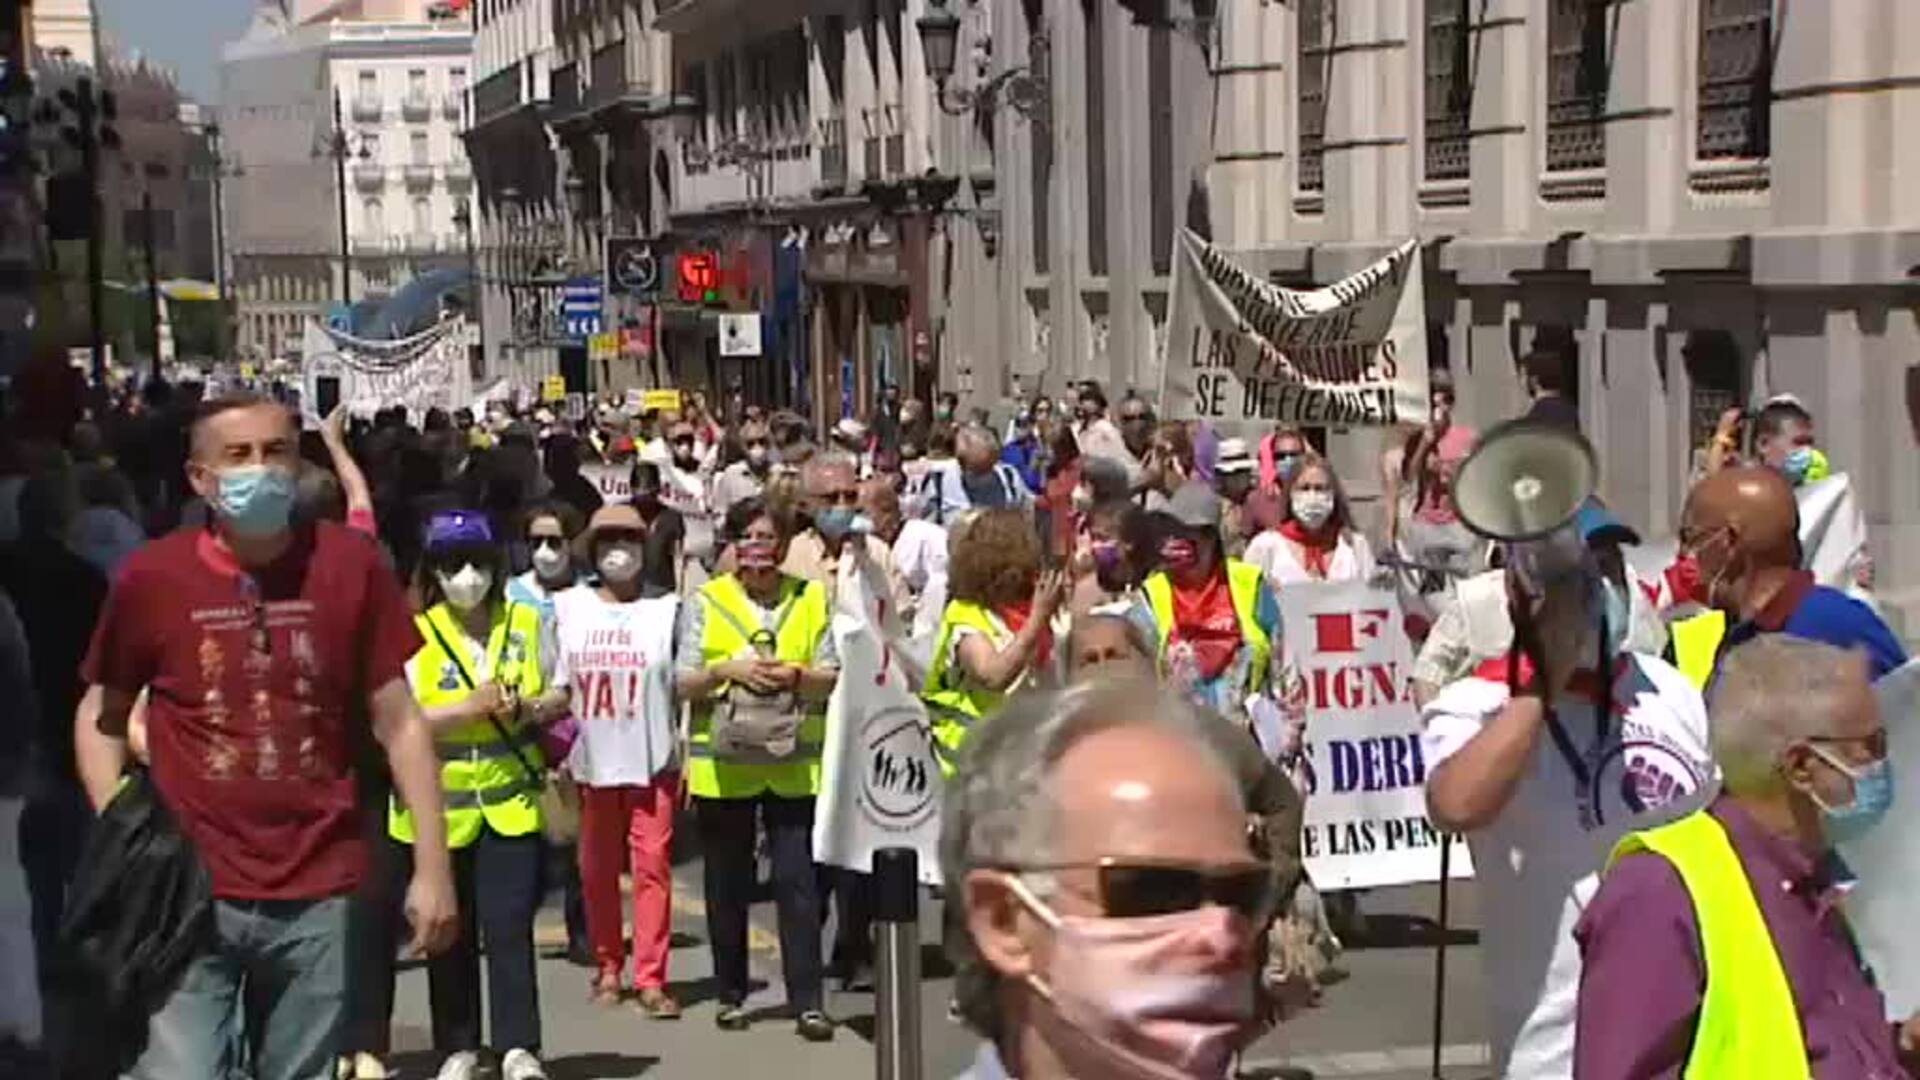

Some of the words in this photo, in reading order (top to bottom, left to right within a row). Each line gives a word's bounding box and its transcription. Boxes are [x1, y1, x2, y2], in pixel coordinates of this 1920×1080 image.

[1192, 328, 1236, 368] LAS
[1196, 373, 1229, 417] SE
[1242, 376, 1398, 425] DEFIENDEN
[1328, 820, 1376, 855] LAS
